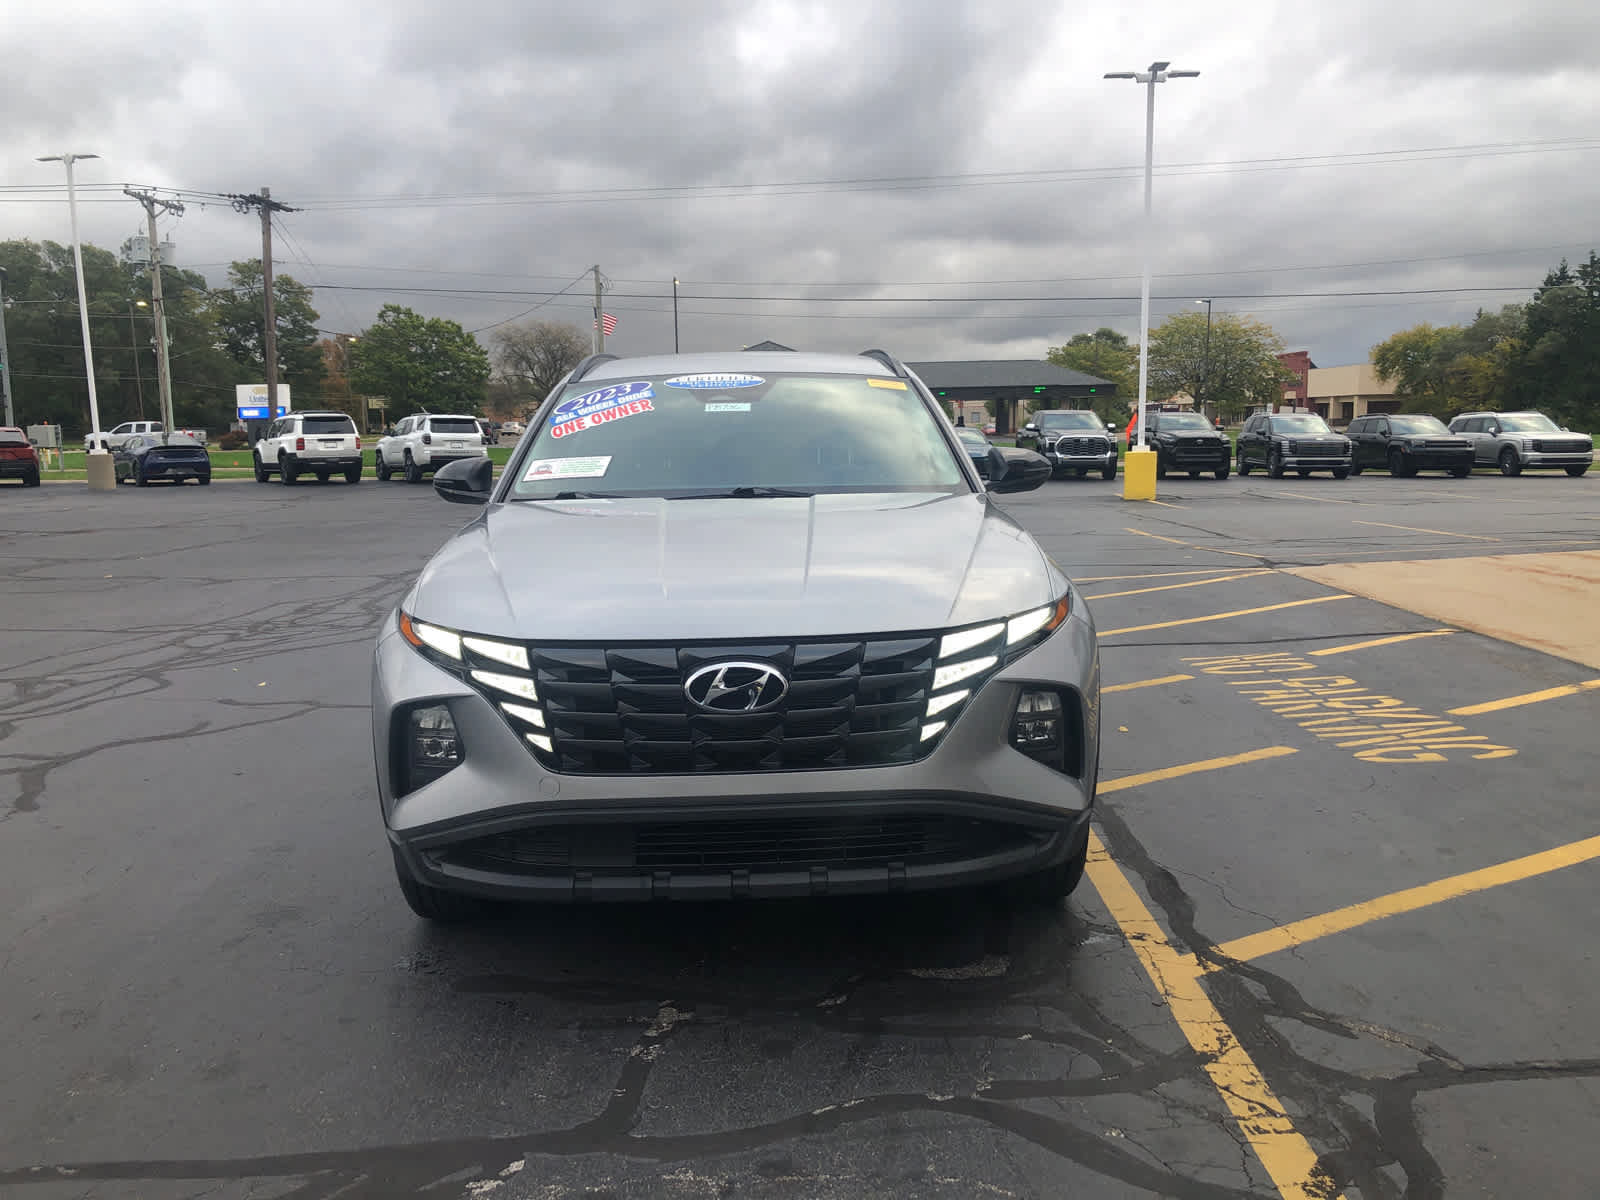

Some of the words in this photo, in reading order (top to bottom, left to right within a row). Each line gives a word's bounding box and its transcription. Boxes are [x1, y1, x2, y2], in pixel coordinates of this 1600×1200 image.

[570, 384, 632, 411] 2023
[552, 417, 586, 438] ONE
[590, 399, 654, 425] OWNER
[1179, 652, 1318, 675] NO
[1224, 675, 1519, 763] PARKING
